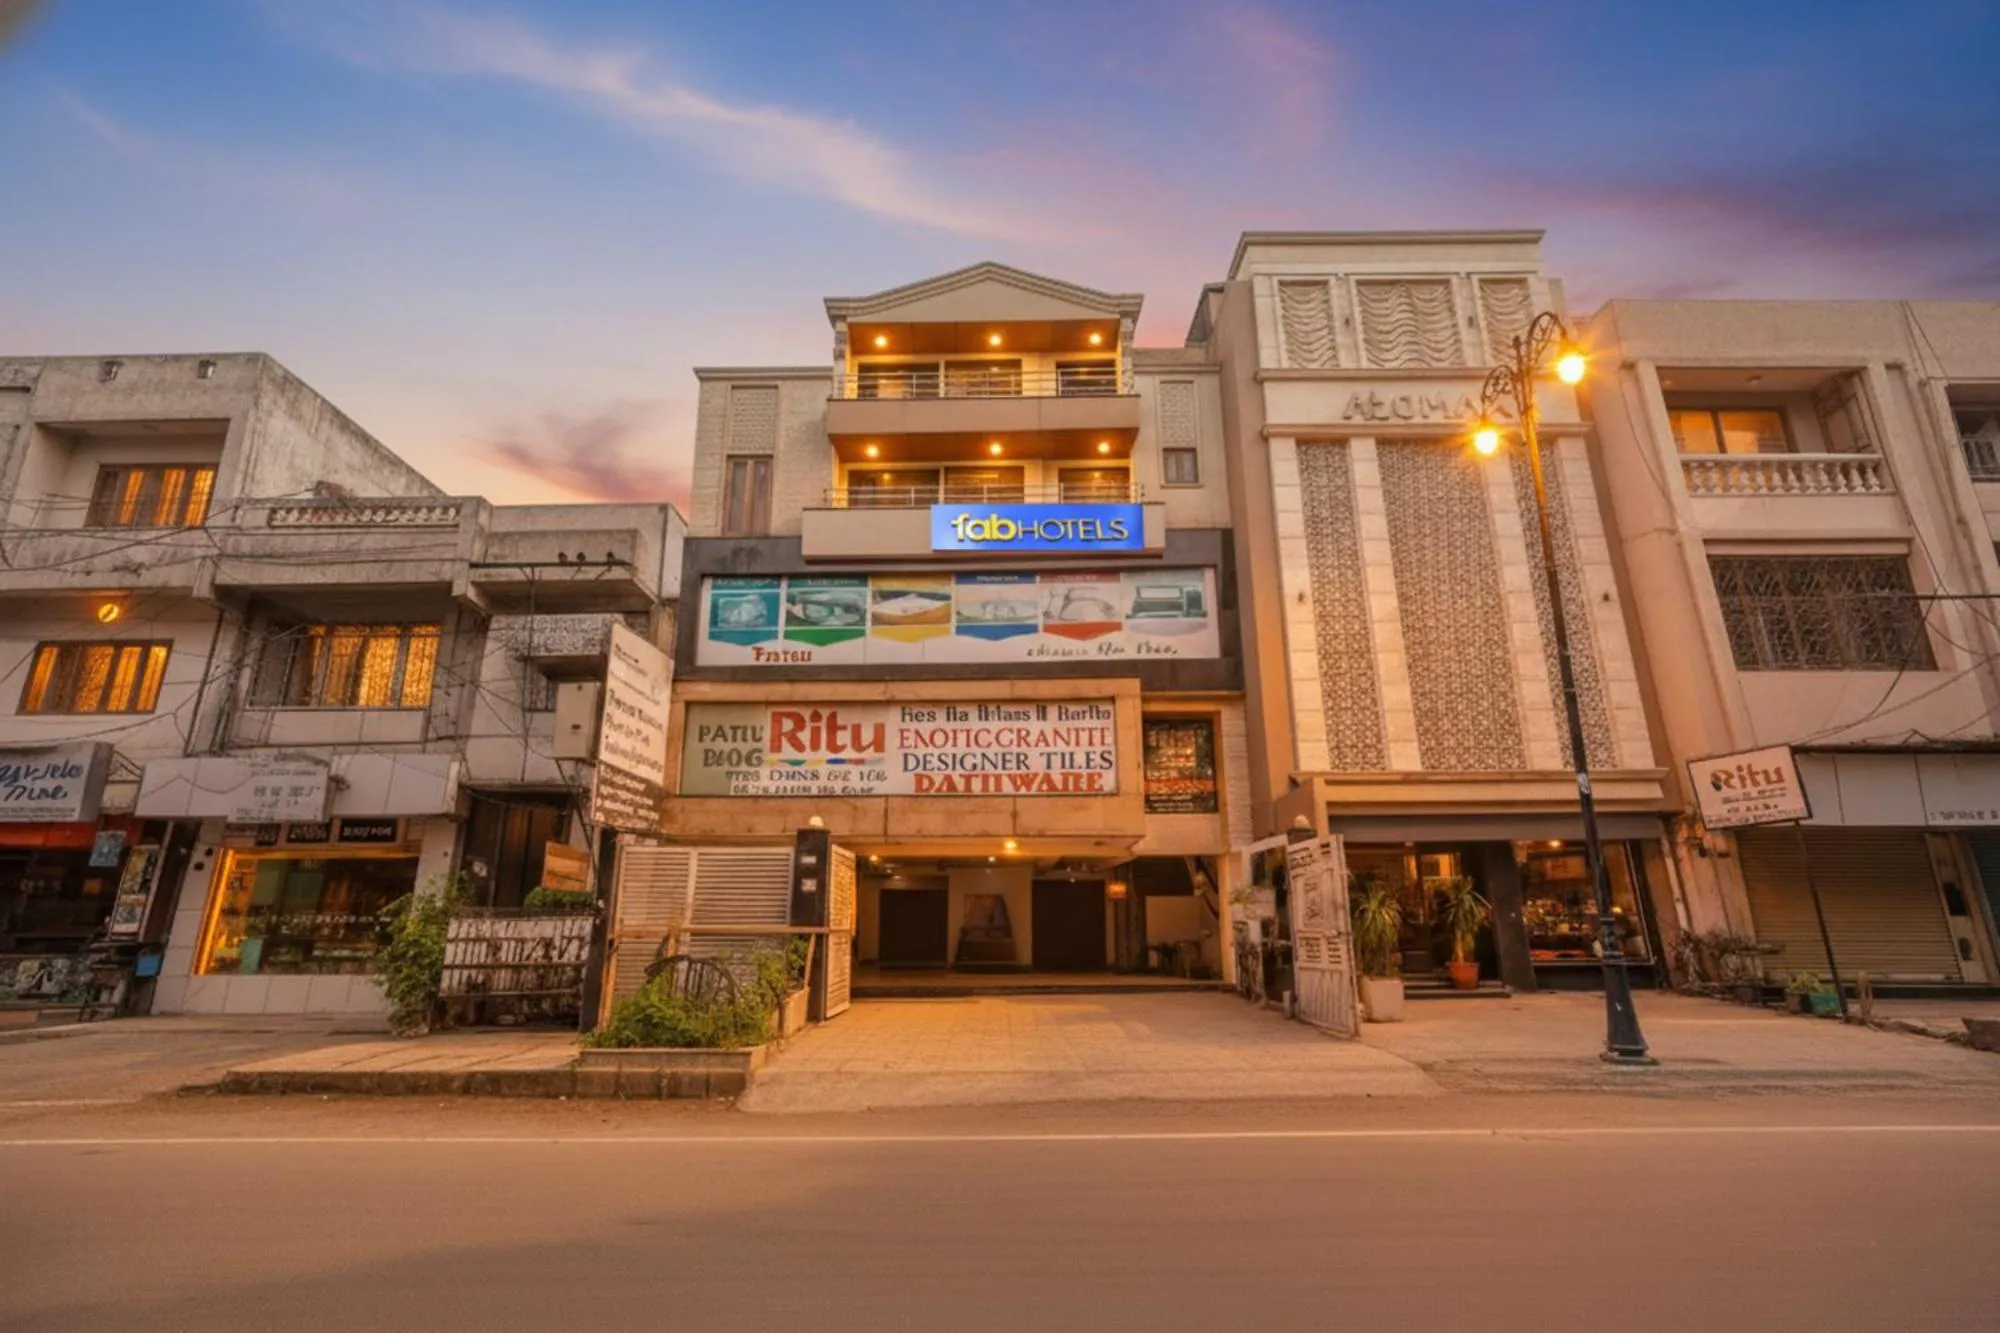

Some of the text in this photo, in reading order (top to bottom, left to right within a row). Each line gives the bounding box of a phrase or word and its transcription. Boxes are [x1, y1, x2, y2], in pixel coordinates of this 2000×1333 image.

[769, 709, 886, 754] Ritu
[902, 750, 1113, 772] DESIGNER TILES
[1710, 763, 1785, 790] Ritu
